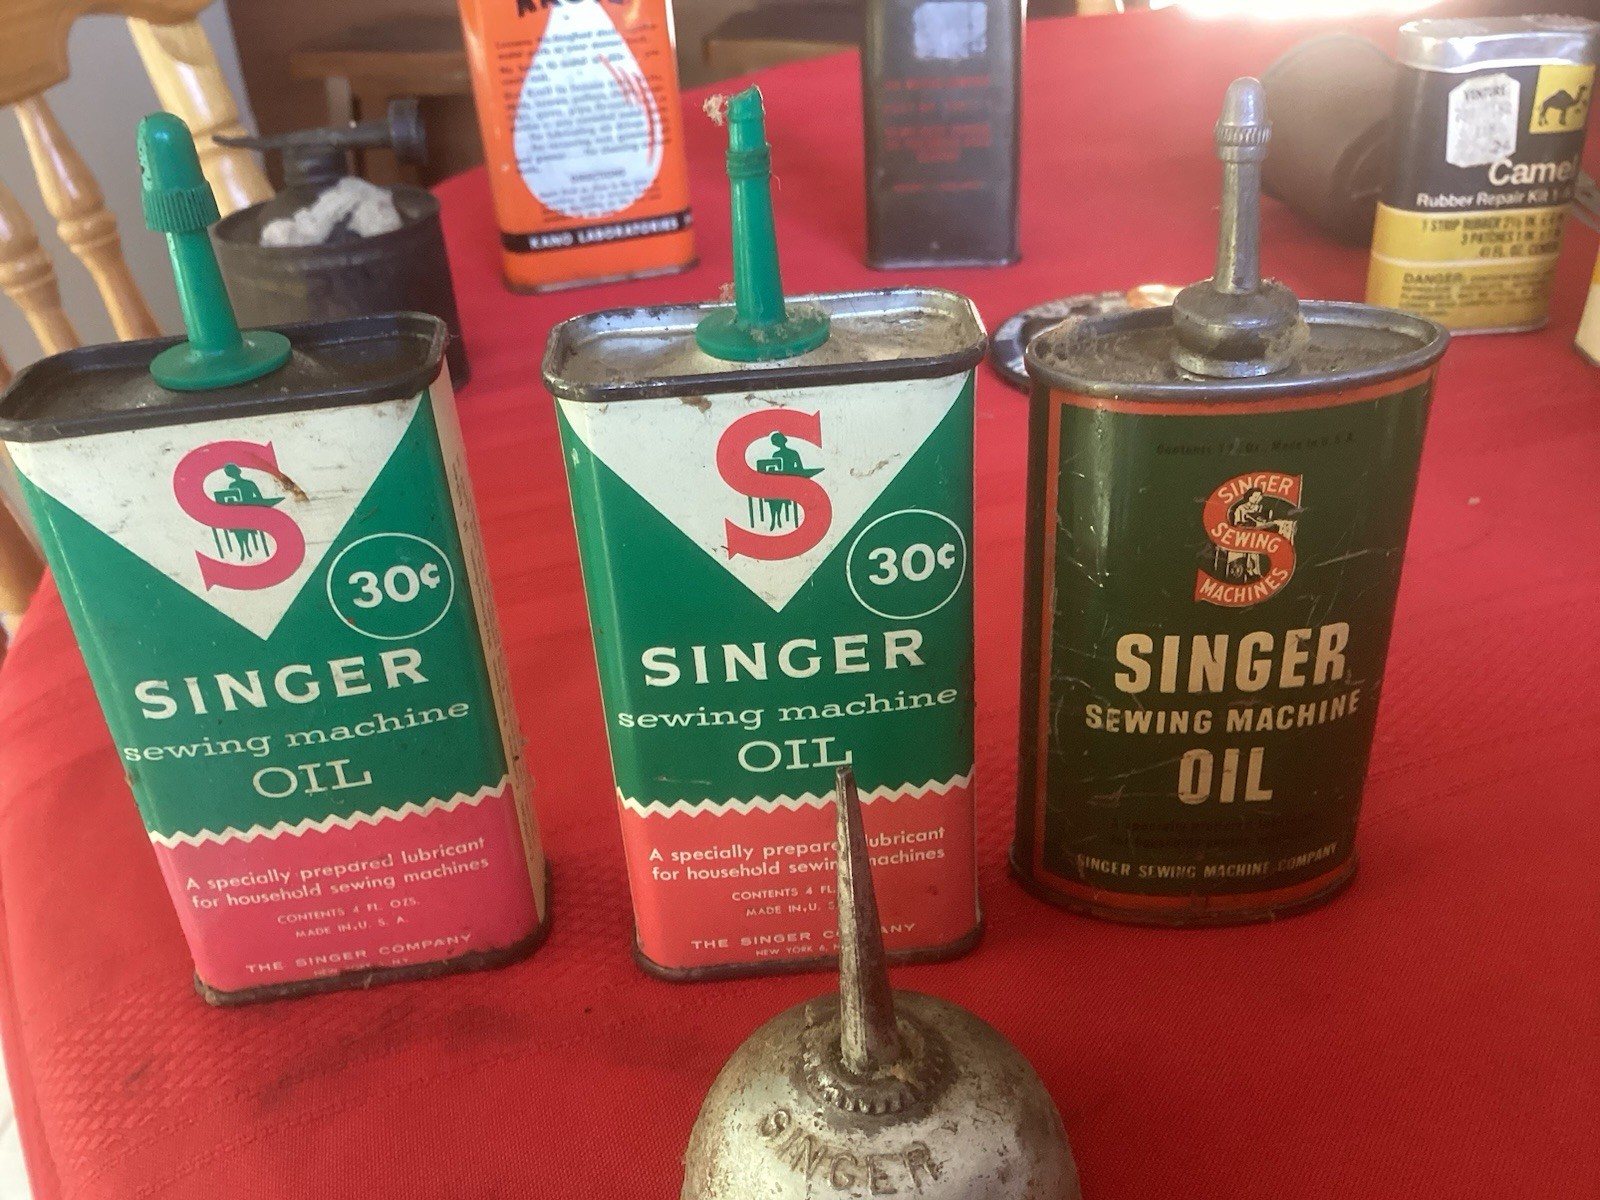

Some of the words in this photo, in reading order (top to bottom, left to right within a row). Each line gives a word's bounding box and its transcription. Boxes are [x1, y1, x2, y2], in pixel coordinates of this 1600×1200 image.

[1416, 192, 1474, 208] Rubber
[1476, 189, 1525, 208] Repair
[1217, 474, 1294, 504] SINGER
[1211, 522, 1281, 554] SEWING
[868, 542, 955, 586] 30¢
[348, 563, 441, 609] 30¢
[1200, 567, 1288, 603] MACHINES
[640, 629, 926, 687] SINGER
[1114, 622, 1350, 694] SINGER
[134, 648, 429, 720] SINGER
[618, 706, 764, 731] sewing
[778, 688, 958, 723] machine
[1085, 703, 1213, 734] SEWING
[1226, 689, 1361, 734] MACHINE
[124, 735, 271, 762] sewing
[287, 702, 470, 748] machine
[738, 736, 852, 773] OIL
[252, 758, 373, 798] OIL
[1178, 747, 1273, 806] OIL
[186, 877, 200, 892] A
[207, 869, 291, 893] specially
[300, 854, 394, 883] prepared
[401, 836, 486, 865] lubricant
[649, 847, 664, 862] A
[671, 842, 754, 865] specially
[763, 838, 839, 860] prepare
[652, 866, 680, 881] for
[687, 861, 780, 880] household
[869, 848, 945, 867] achines
[1077, 853, 1132, 877] SINGER
[1138, 865, 1197, 879] SEWING
[1203, 860, 1270, 878] MACHINE
[1276, 841, 1339, 873] COMPANY
[192, 892, 220, 910] for
[226, 882, 323, 908] household
[330, 873, 396, 894] sewing
[404, 856, 490, 884] machines
[732, 886, 799, 902] CONTENTS
[805, 886, 813, 896] 4
[277, 907, 346, 925] CONTENTS
[746, 905, 782, 918] MADE
[295, 926, 332, 939] MADE
[691, 938, 729, 950] THE
[739, 931, 812, 947] SINGER
[755, 947, 781, 958] NEW
[786, 945, 814, 955] YORK
[245, 960, 284, 975] THE
[295, 949, 368, 969] SINGER
[378, 934, 473, 957] COMPANY
[758, 1108, 946, 1197] SINGER
